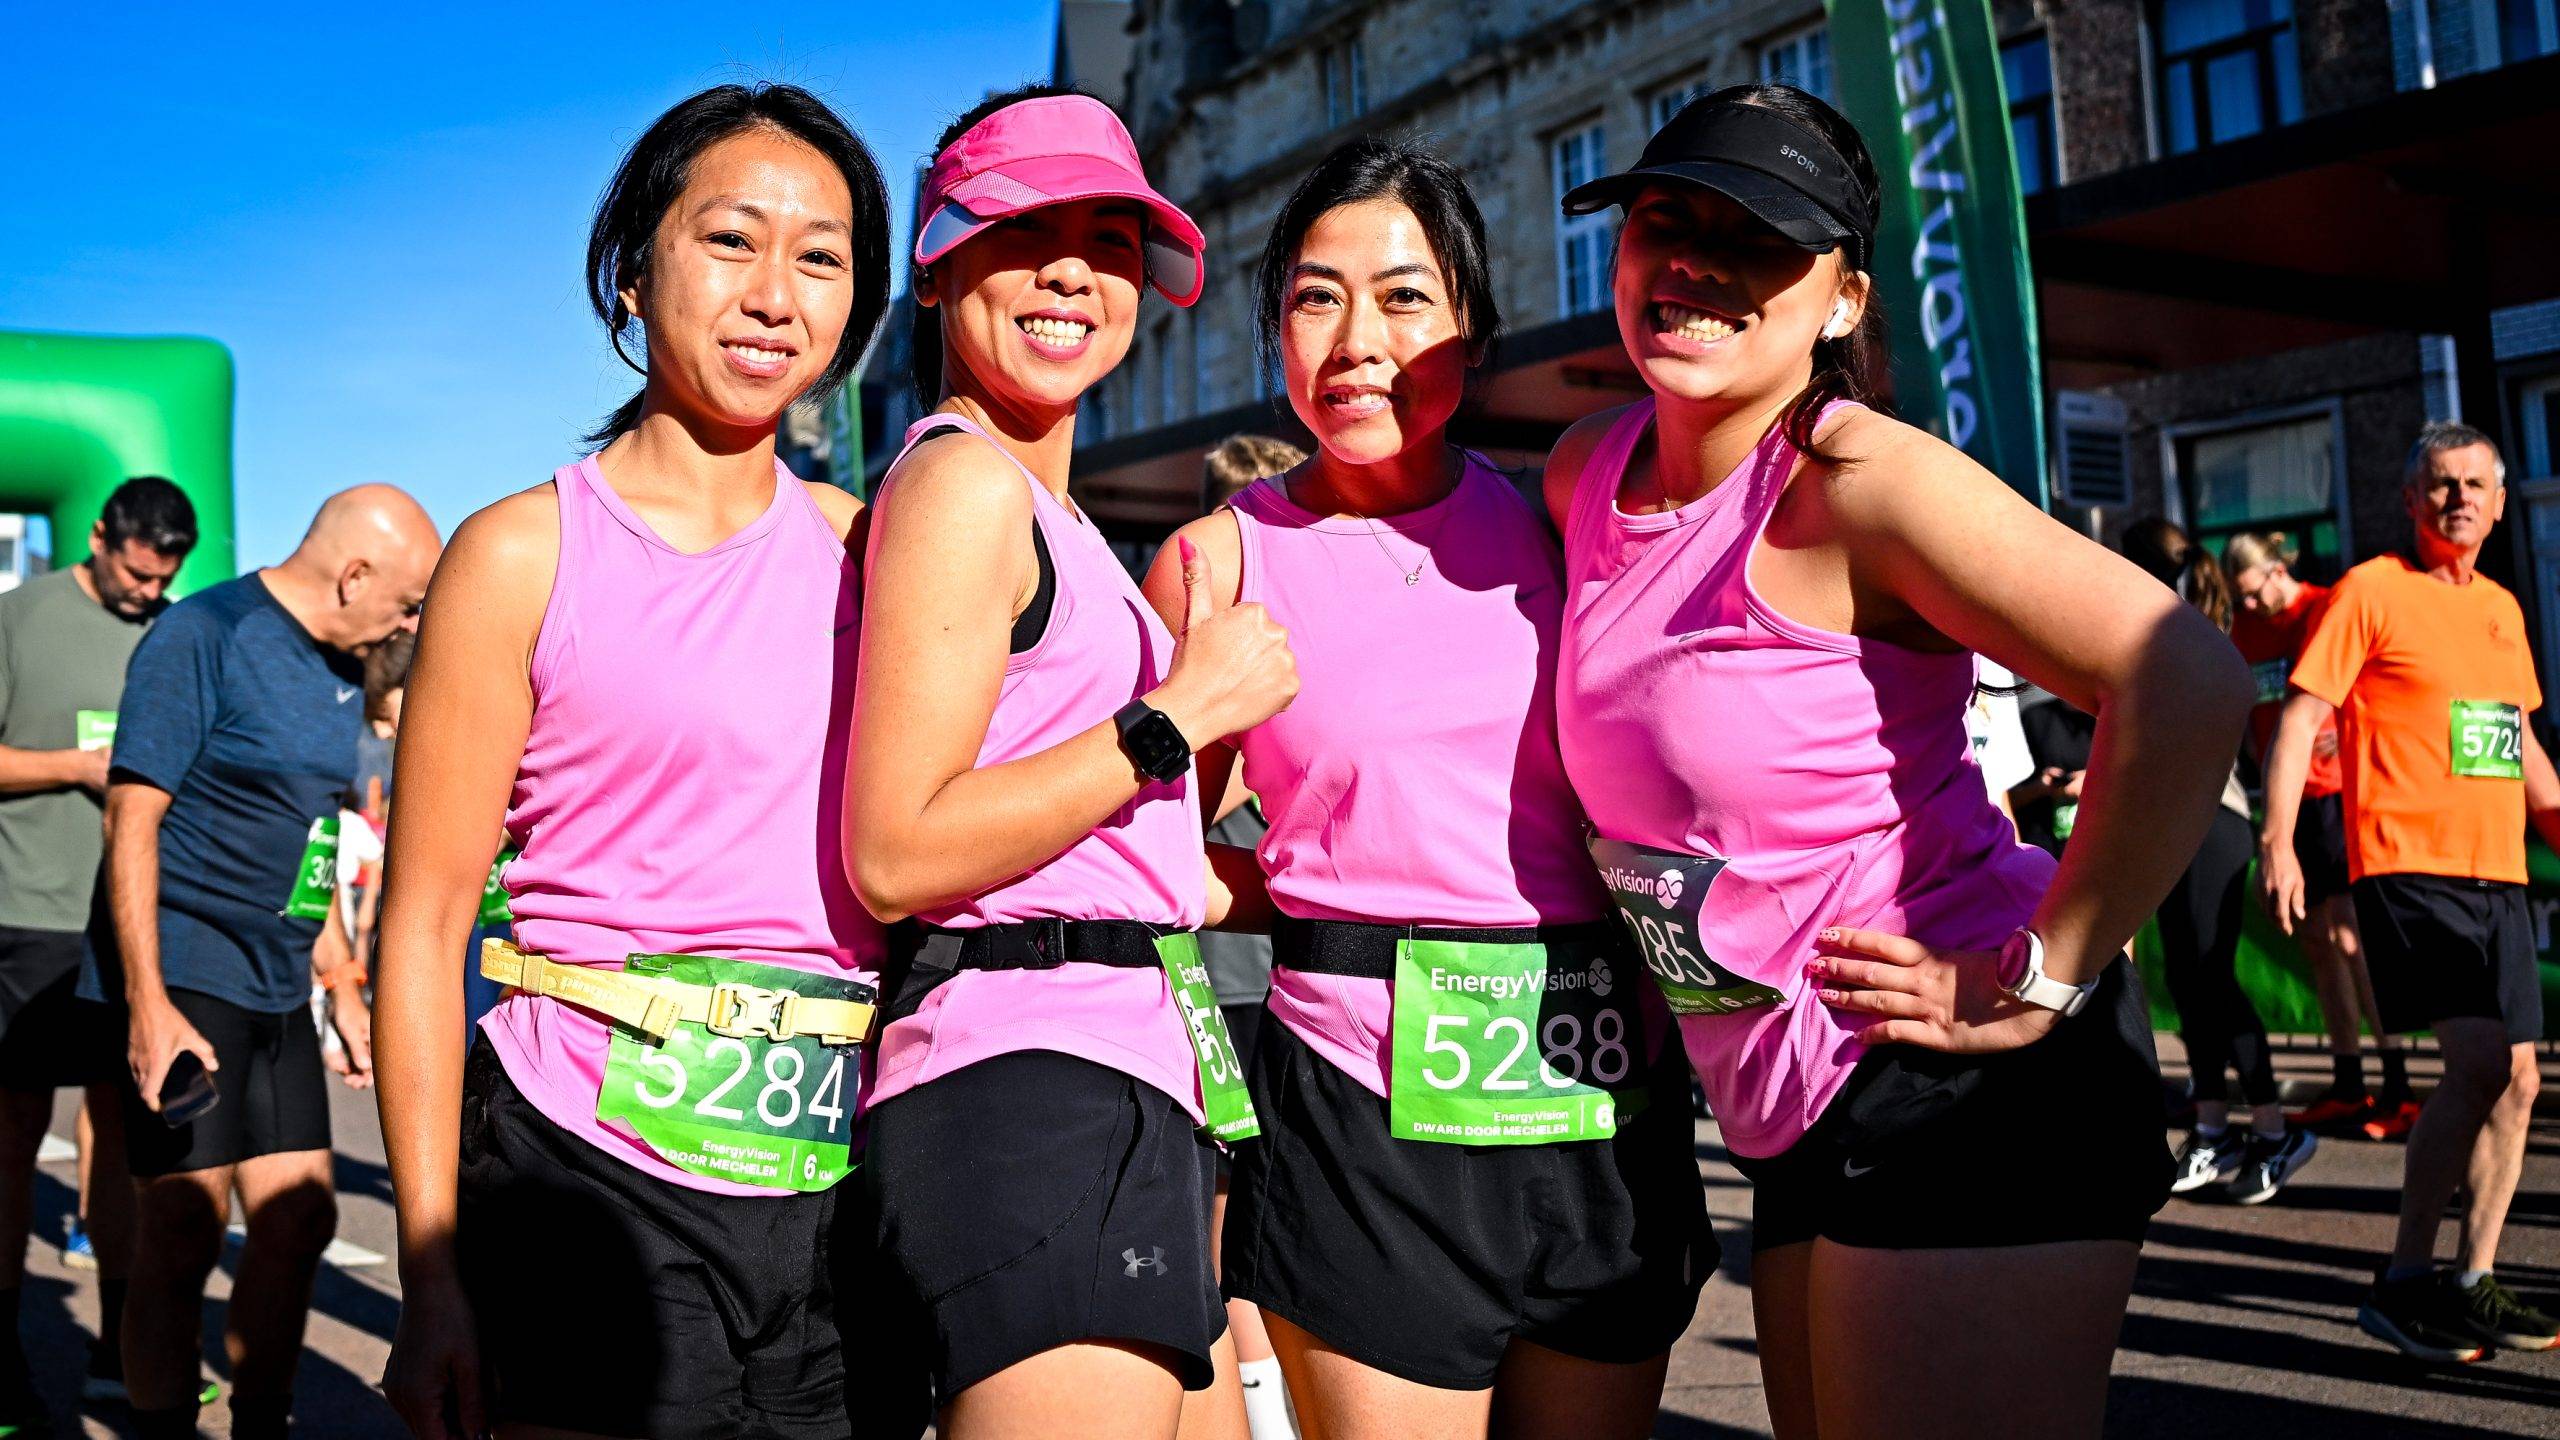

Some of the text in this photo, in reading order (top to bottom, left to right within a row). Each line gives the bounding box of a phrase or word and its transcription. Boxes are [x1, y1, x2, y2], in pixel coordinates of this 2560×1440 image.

[1780, 145, 1822, 177] SPORT
[2462, 724, 2521, 761] 5724
[306, 854, 336, 890] 30
[1620, 906, 1717, 986] 285
[1430, 967, 1586, 999] EnergyVision
[1421, 1008, 1629, 1091] 5288
[634, 1028, 844, 1134] 5284
[1413, 1123, 1569, 1137] DWARS DOOR MECHELEN
[1493, 1110, 1569, 1124] EnergyVision
[1595, 1104, 1632, 1129] 6 KM
[668, 1149, 707, 1167] DOOR
[708, 1157, 778, 1178] MECHELEN
[701, 1139, 780, 1163] EnergyVision
[803, 1153, 818, 1181] 6
